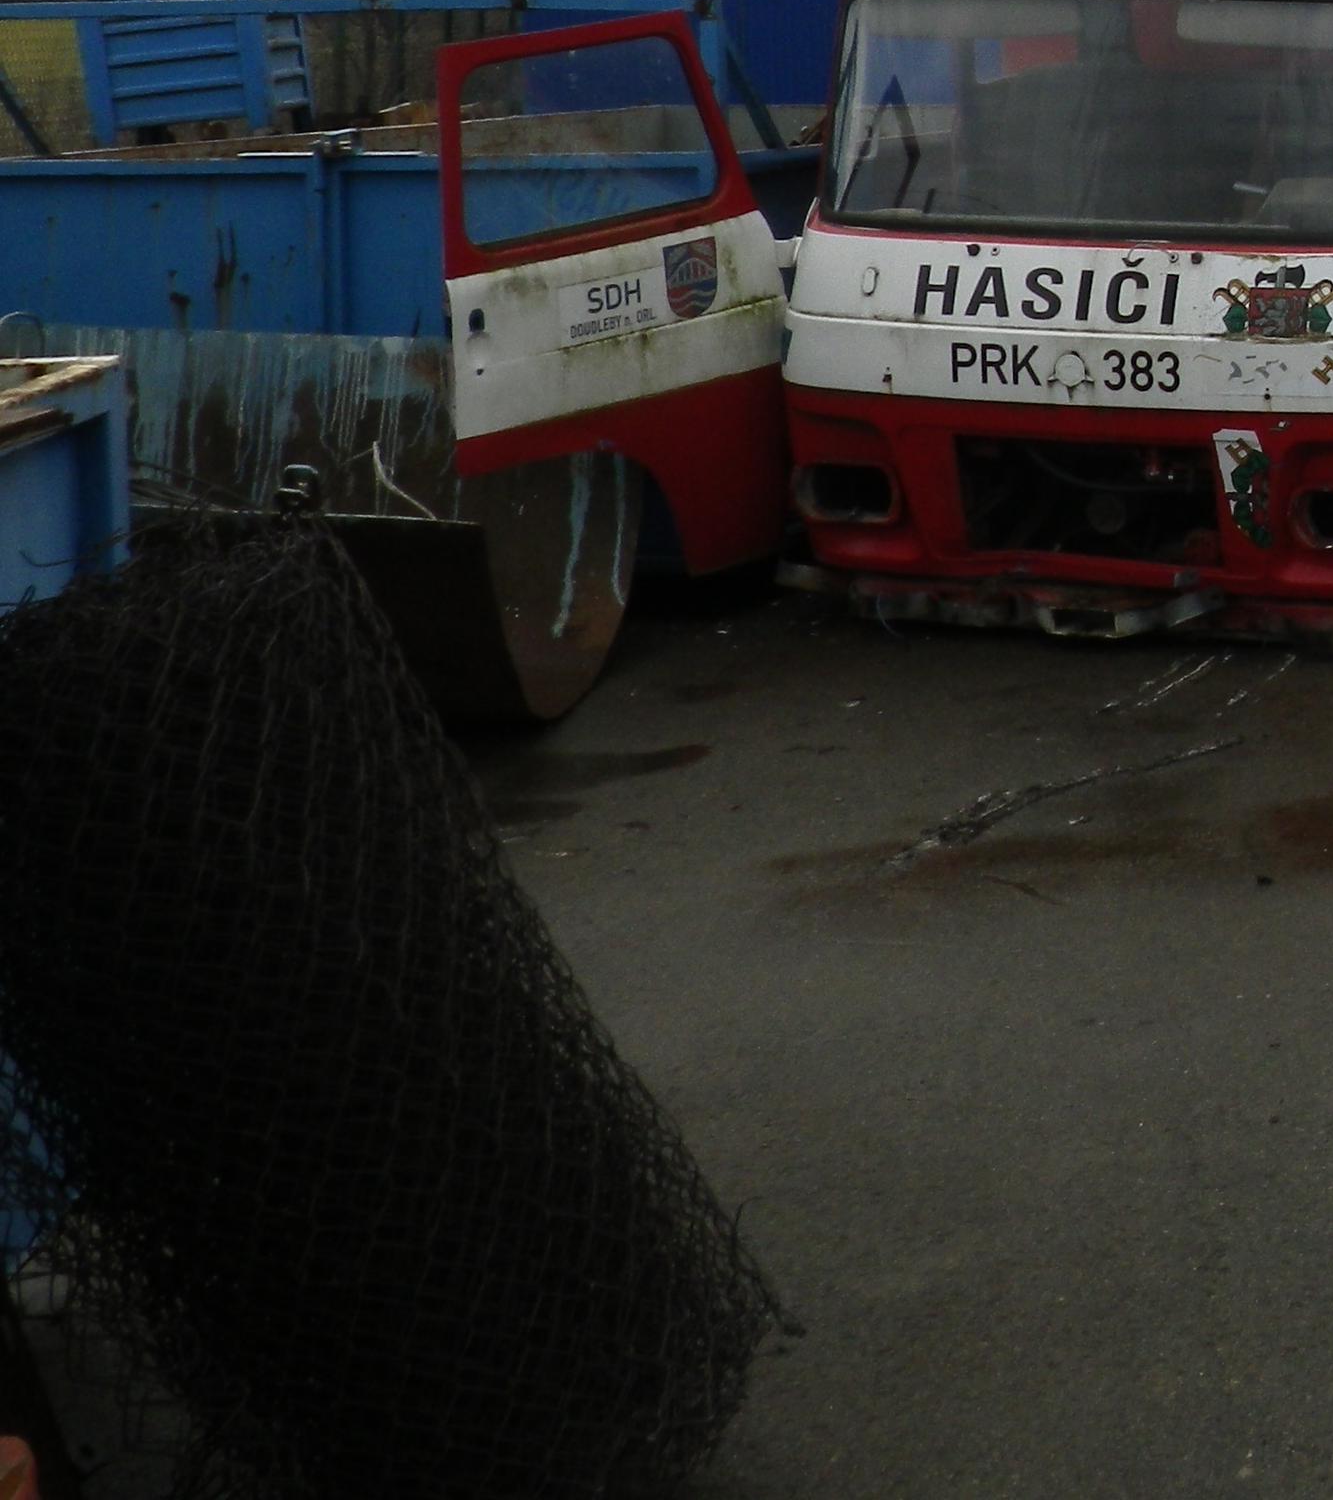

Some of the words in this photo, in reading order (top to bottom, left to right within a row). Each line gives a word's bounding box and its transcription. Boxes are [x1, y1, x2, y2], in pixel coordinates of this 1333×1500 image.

[587, 278, 641, 314] SDH
[914, 257, 1181, 325] HASIČI
[570, 316, 622, 338] DOUDLEBY
[951, 343, 1041, 386] PRK
[1103, 350, 1181, 392] 383
